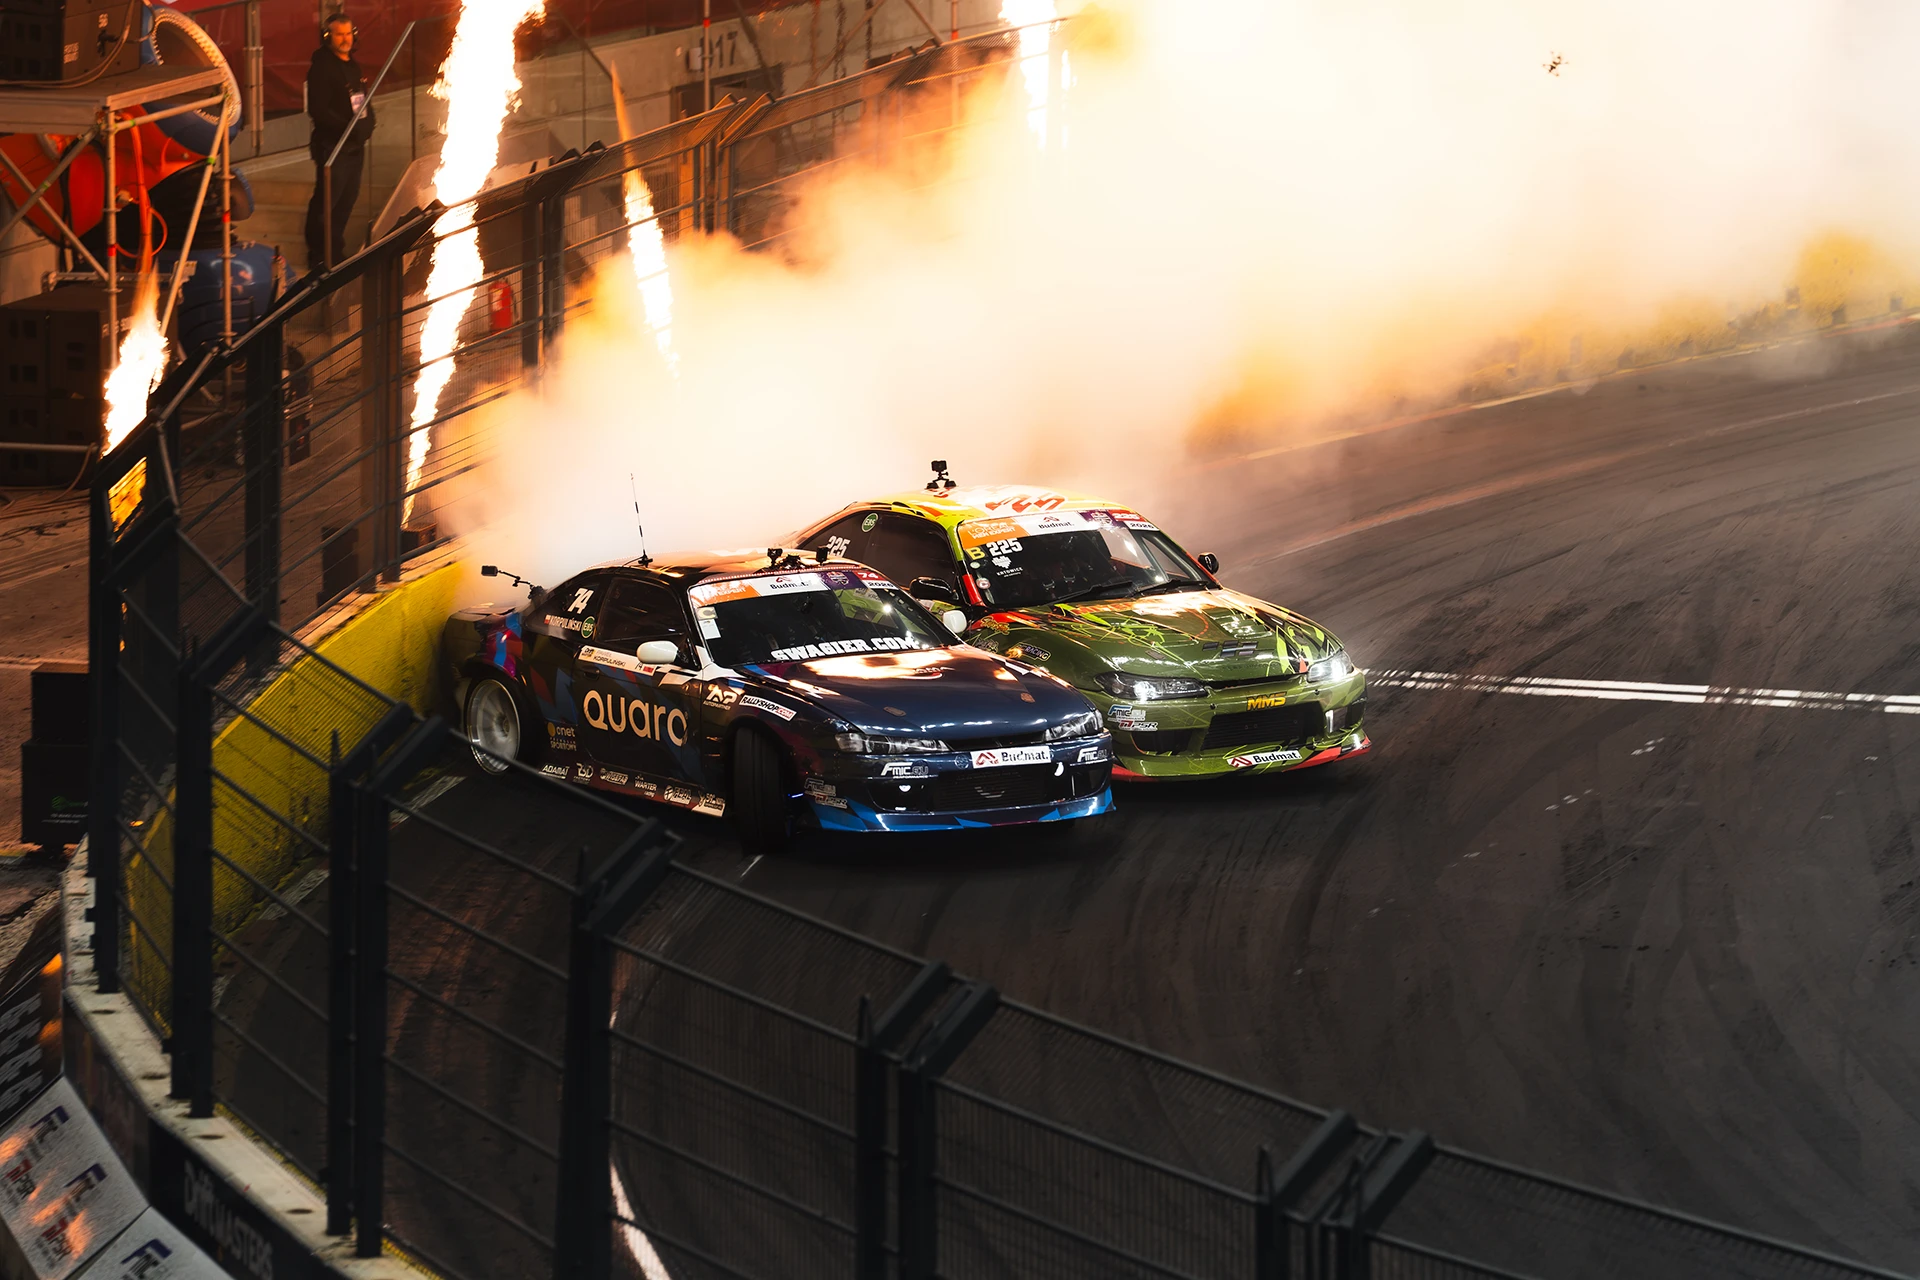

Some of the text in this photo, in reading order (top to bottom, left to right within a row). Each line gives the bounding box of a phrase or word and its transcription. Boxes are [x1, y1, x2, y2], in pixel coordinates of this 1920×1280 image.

[965, 546, 986, 561] B
[986, 537, 1023, 557] 225
[567, 587, 594, 614] 74
[770, 637, 919, 661] SWAGIER.COM
[1246, 691, 1287, 711] MMS
